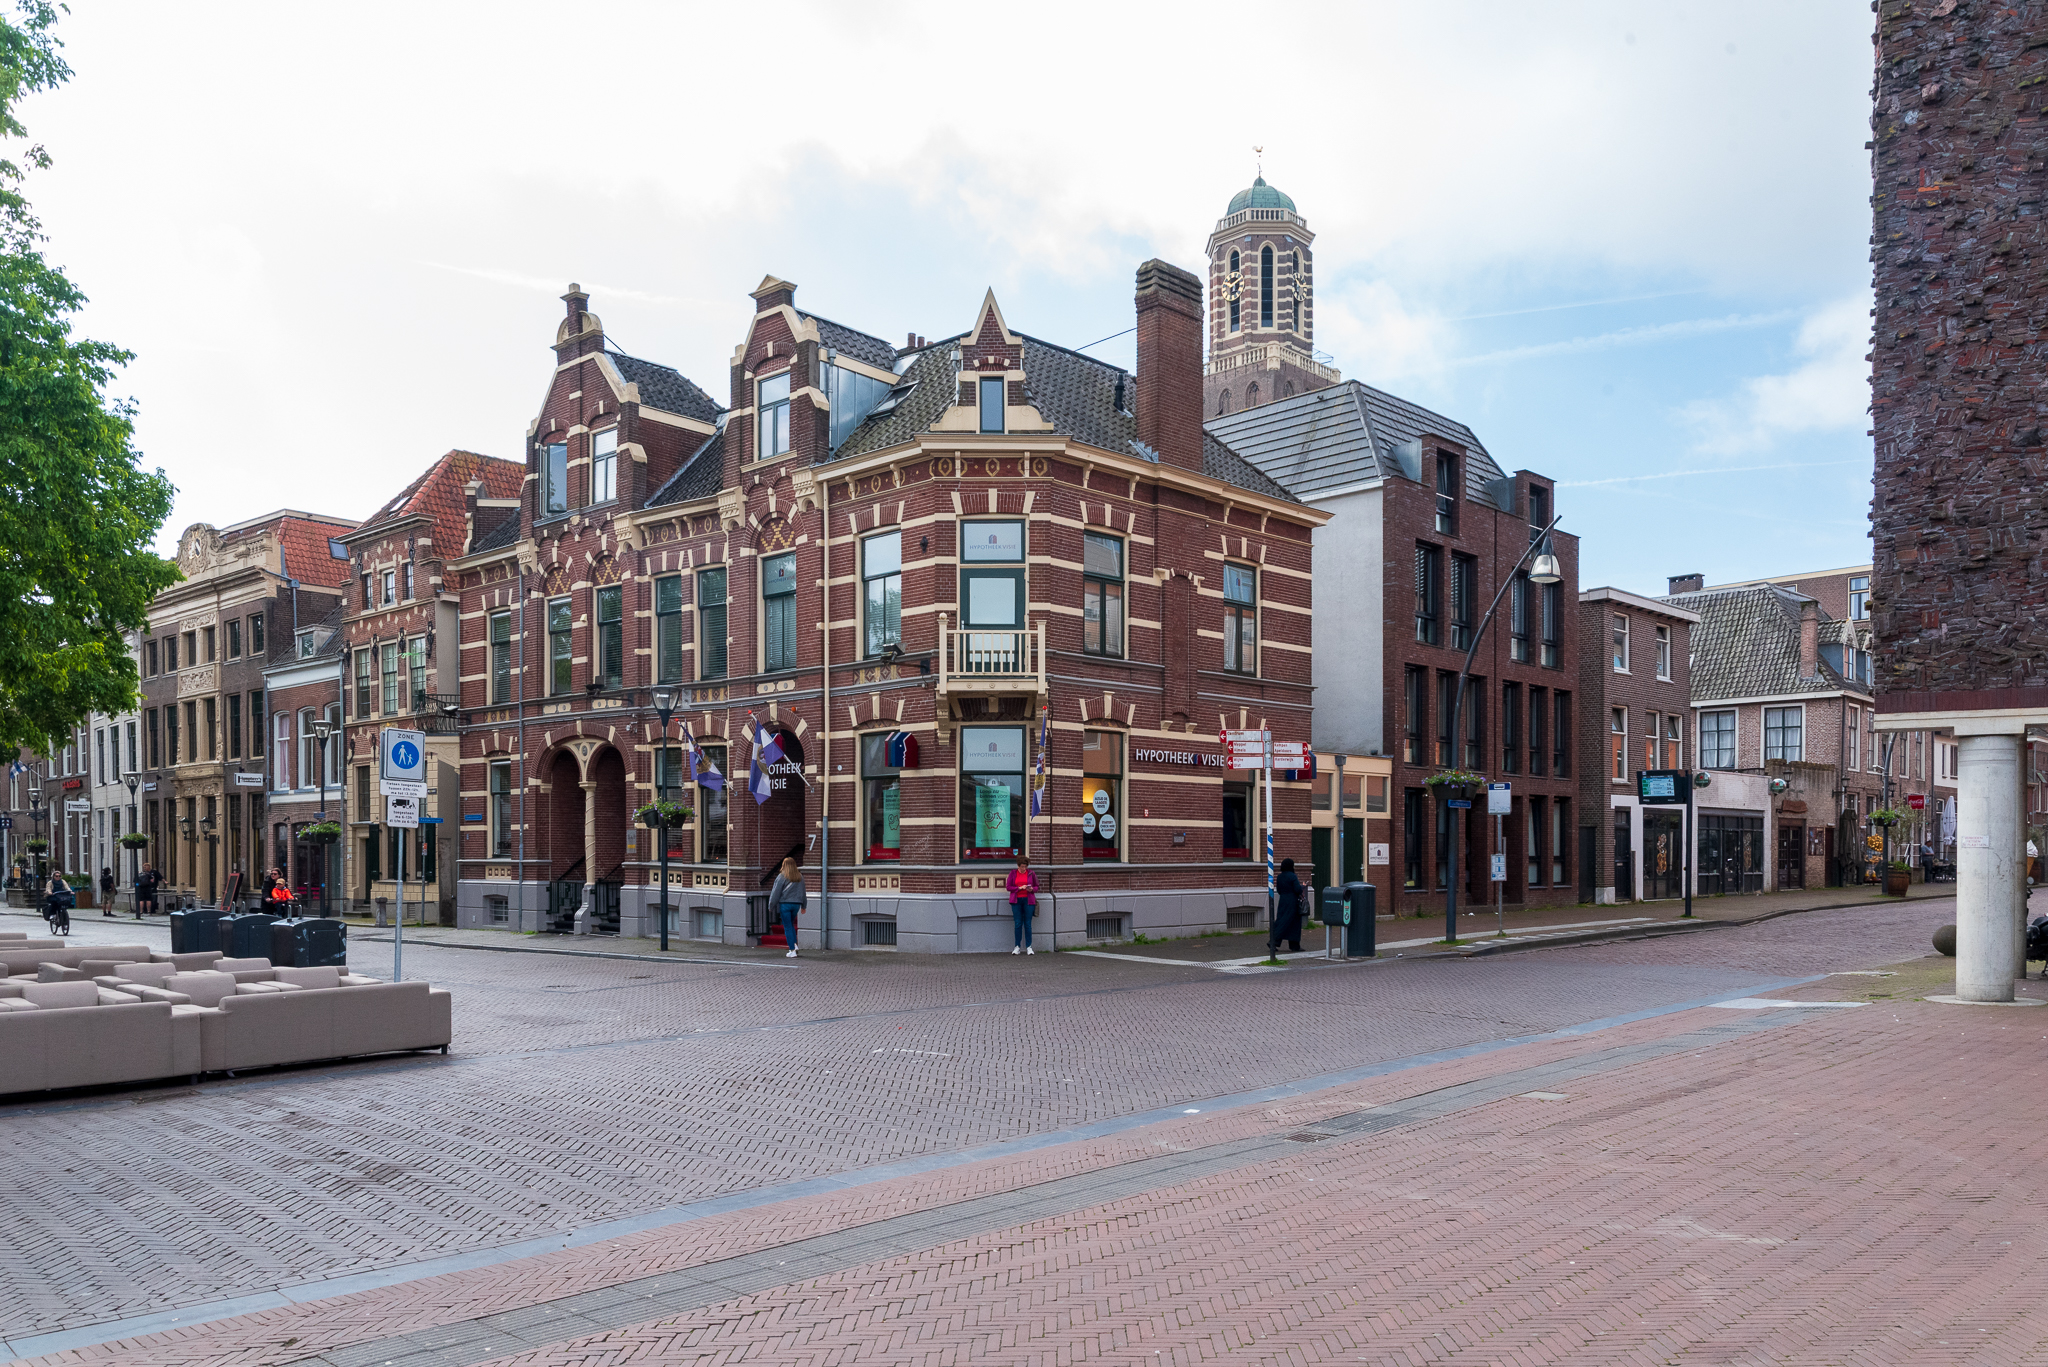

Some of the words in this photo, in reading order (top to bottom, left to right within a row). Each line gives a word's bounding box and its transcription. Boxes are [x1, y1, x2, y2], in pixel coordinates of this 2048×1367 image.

[1135, 748, 1194, 765] HYPOTHEEK
[1201, 753, 1225, 767] VISIE
[768, 762, 802, 775] OTHEEK
[807, 833, 817, 851] 7
